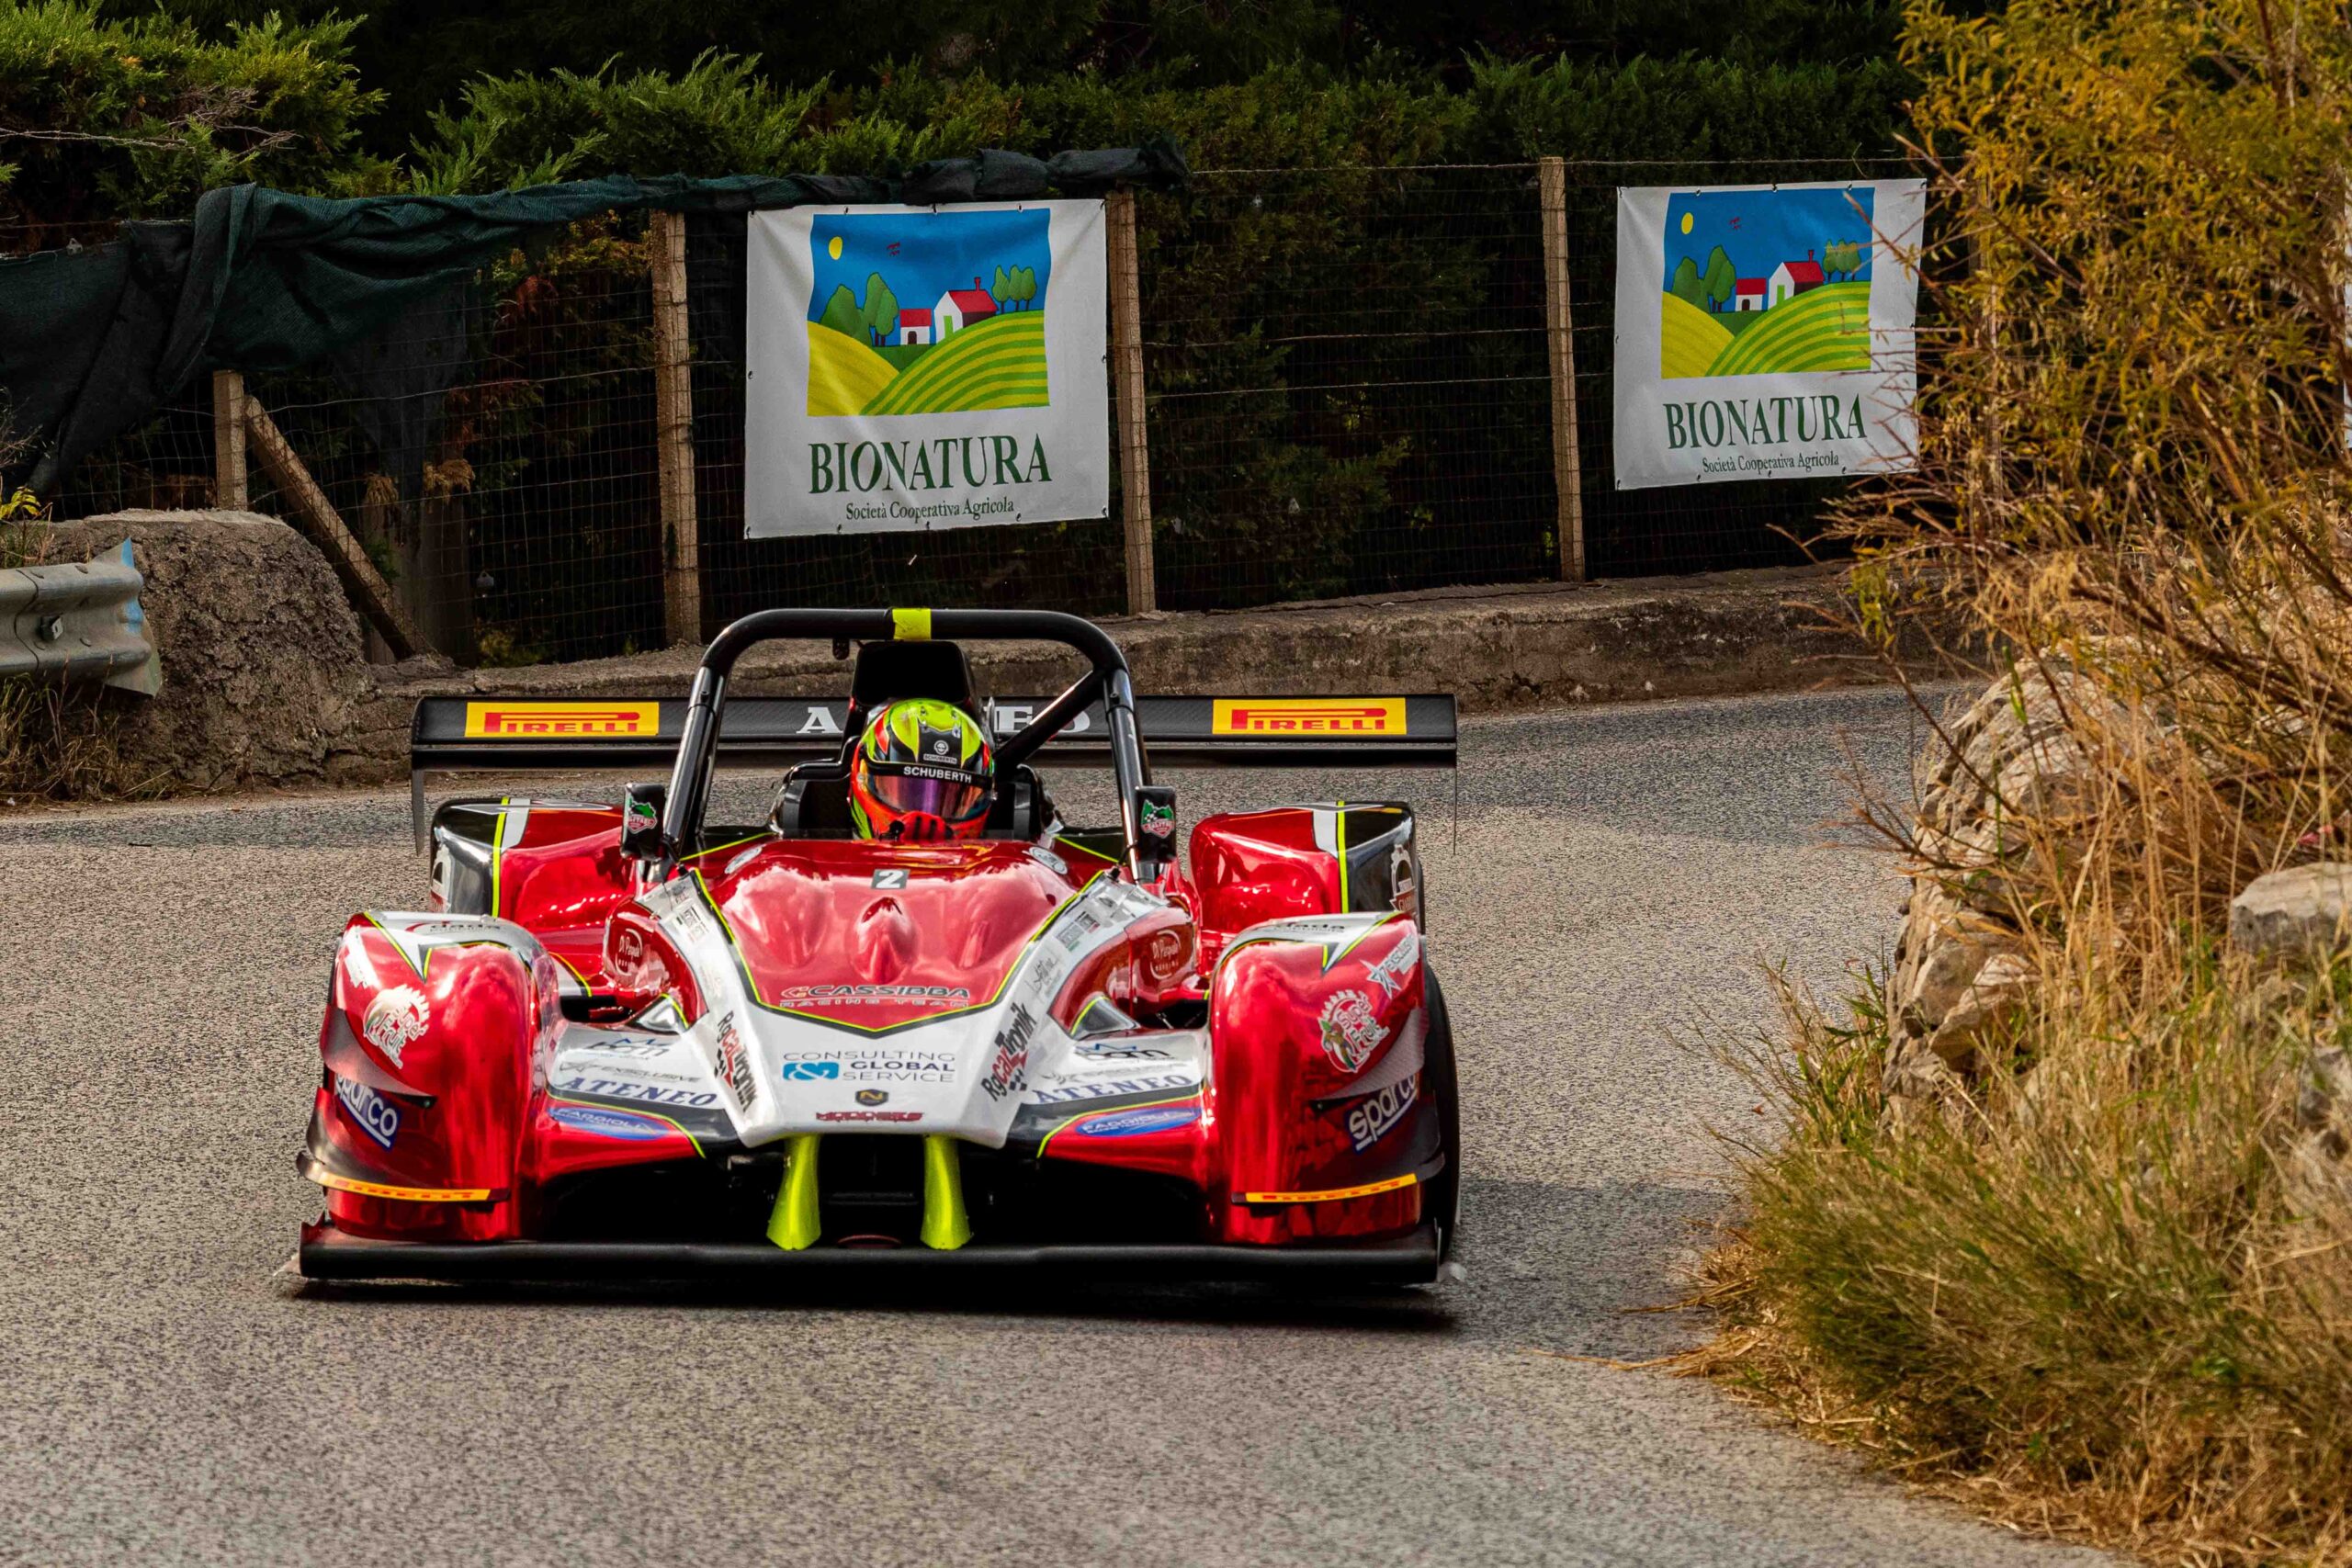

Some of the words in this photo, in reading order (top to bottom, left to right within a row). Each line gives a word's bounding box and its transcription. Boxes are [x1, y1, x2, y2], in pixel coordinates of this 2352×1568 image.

[1663, 393, 1867, 450] BIONATURA
[808, 433, 1053, 495] BIONATURA
[1702, 456, 1736, 473] Società
[1738, 453, 1795, 477] Cooperativa
[1797, 452, 1839, 472] Agricola
[846, 500, 888, 521] Società
[889, 500, 960, 524] Cooperativa
[962, 495, 1014, 521] Agricola
[484, 711, 640, 733] PIRELLI
[1231, 707, 1387, 731] PIRELLI
[903, 766, 973, 783] SCHUBERTH
[876, 869, 905, 889] 2
[809, 985, 970, 998] CASSIBBA
[784, 1050, 956, 1063] CONSULTING
[851, 1060, 956, 1072] GLOBAL
[842, 1071, 955, 1083] SERVICE
[559, 1077, 718, 1107] ATENEO
[1032, 1074, 1192, 1104] ATENEO
